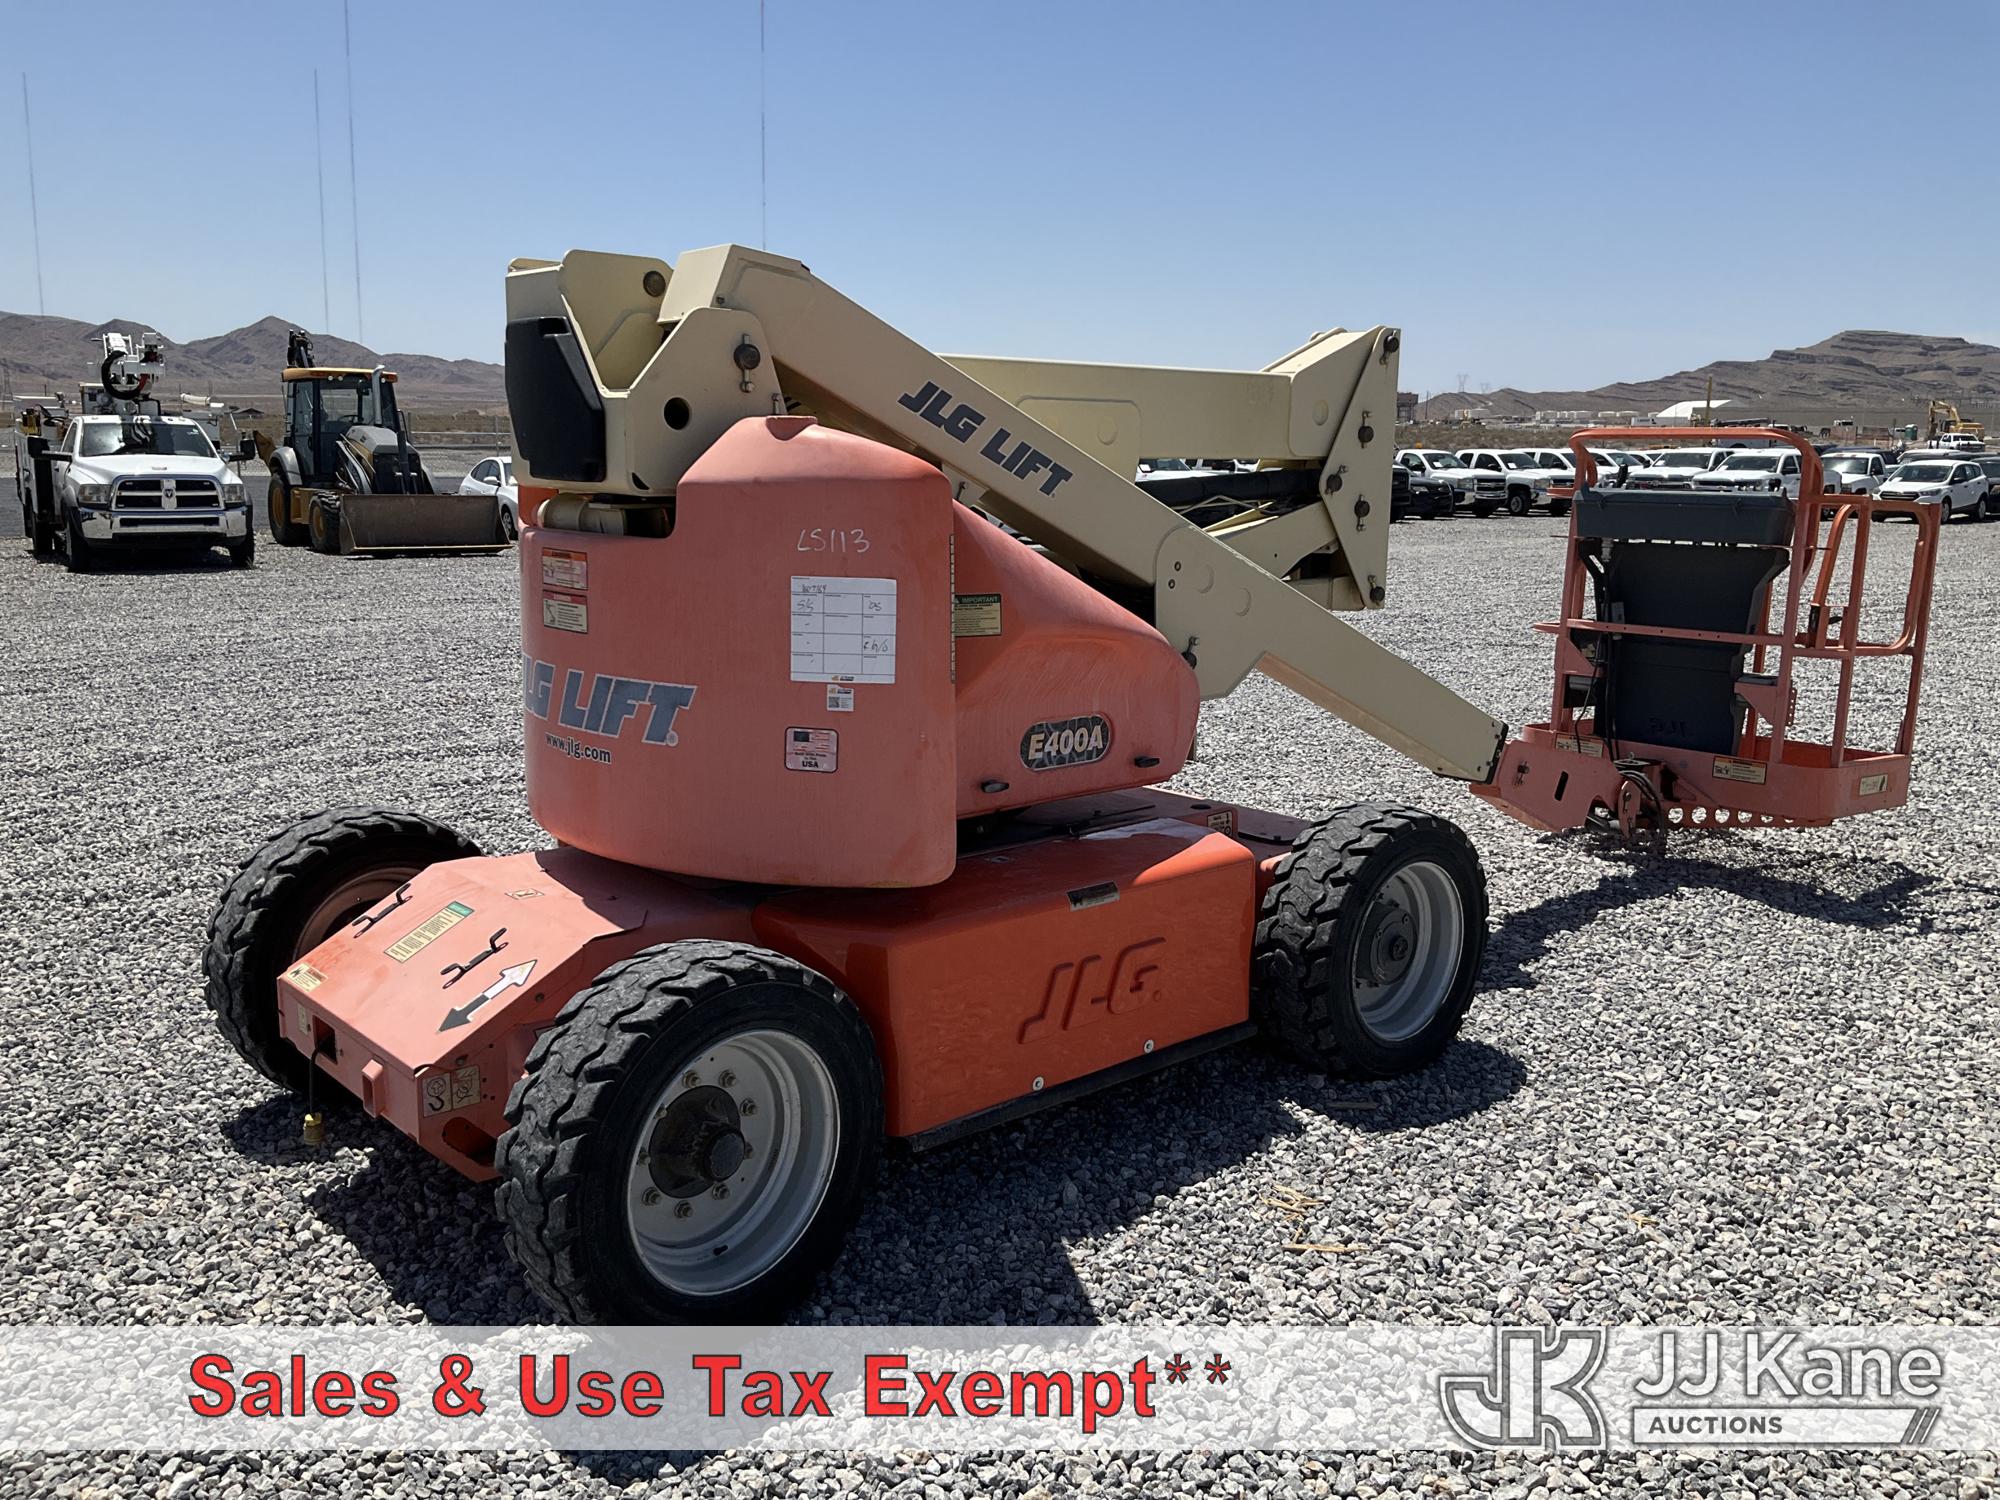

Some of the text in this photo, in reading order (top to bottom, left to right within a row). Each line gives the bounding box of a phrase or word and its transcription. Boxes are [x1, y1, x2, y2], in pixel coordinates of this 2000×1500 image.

[897, 380, 1073, 497] JLG LIFT
[523, 652, 698, 745] LG LIFT
[546, 733, 611, 763] www.jlg.com
[802, 760, 819, 769] USA
[1028, 725, 1104, 761] E400A
[1016, 936, 1167, 1045] JLG
